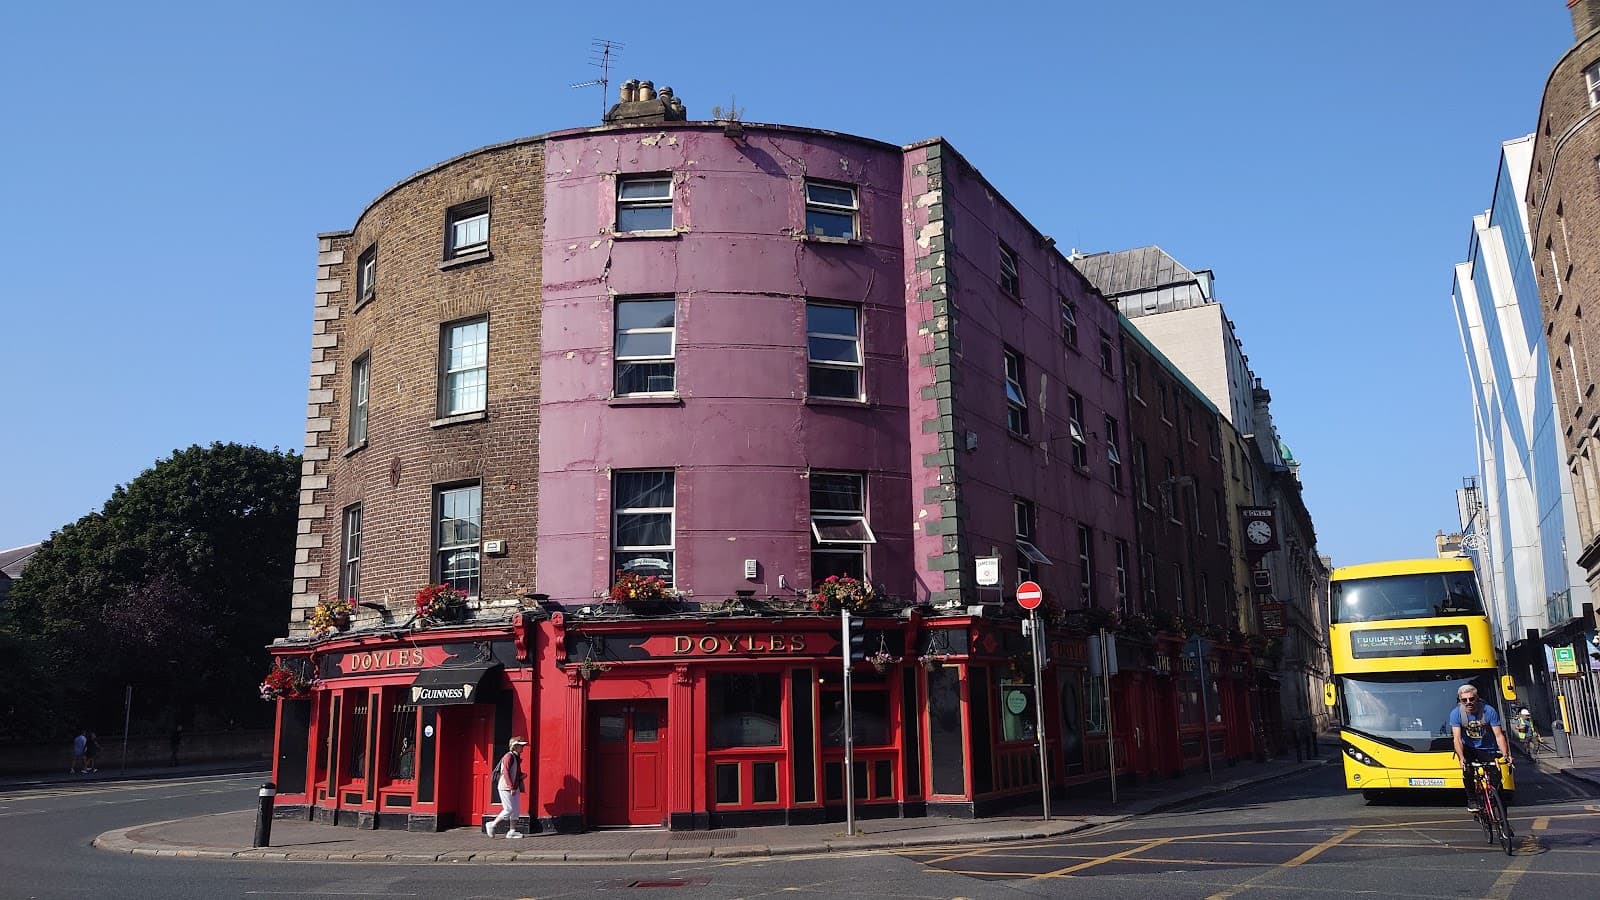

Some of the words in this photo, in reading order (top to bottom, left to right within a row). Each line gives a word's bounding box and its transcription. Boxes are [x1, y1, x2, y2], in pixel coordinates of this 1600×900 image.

[673, 633, 806, 654] DOYLES
[351, 649, 424, 670] DOYLES
[420, 688, 463, 699] GUINNESS
